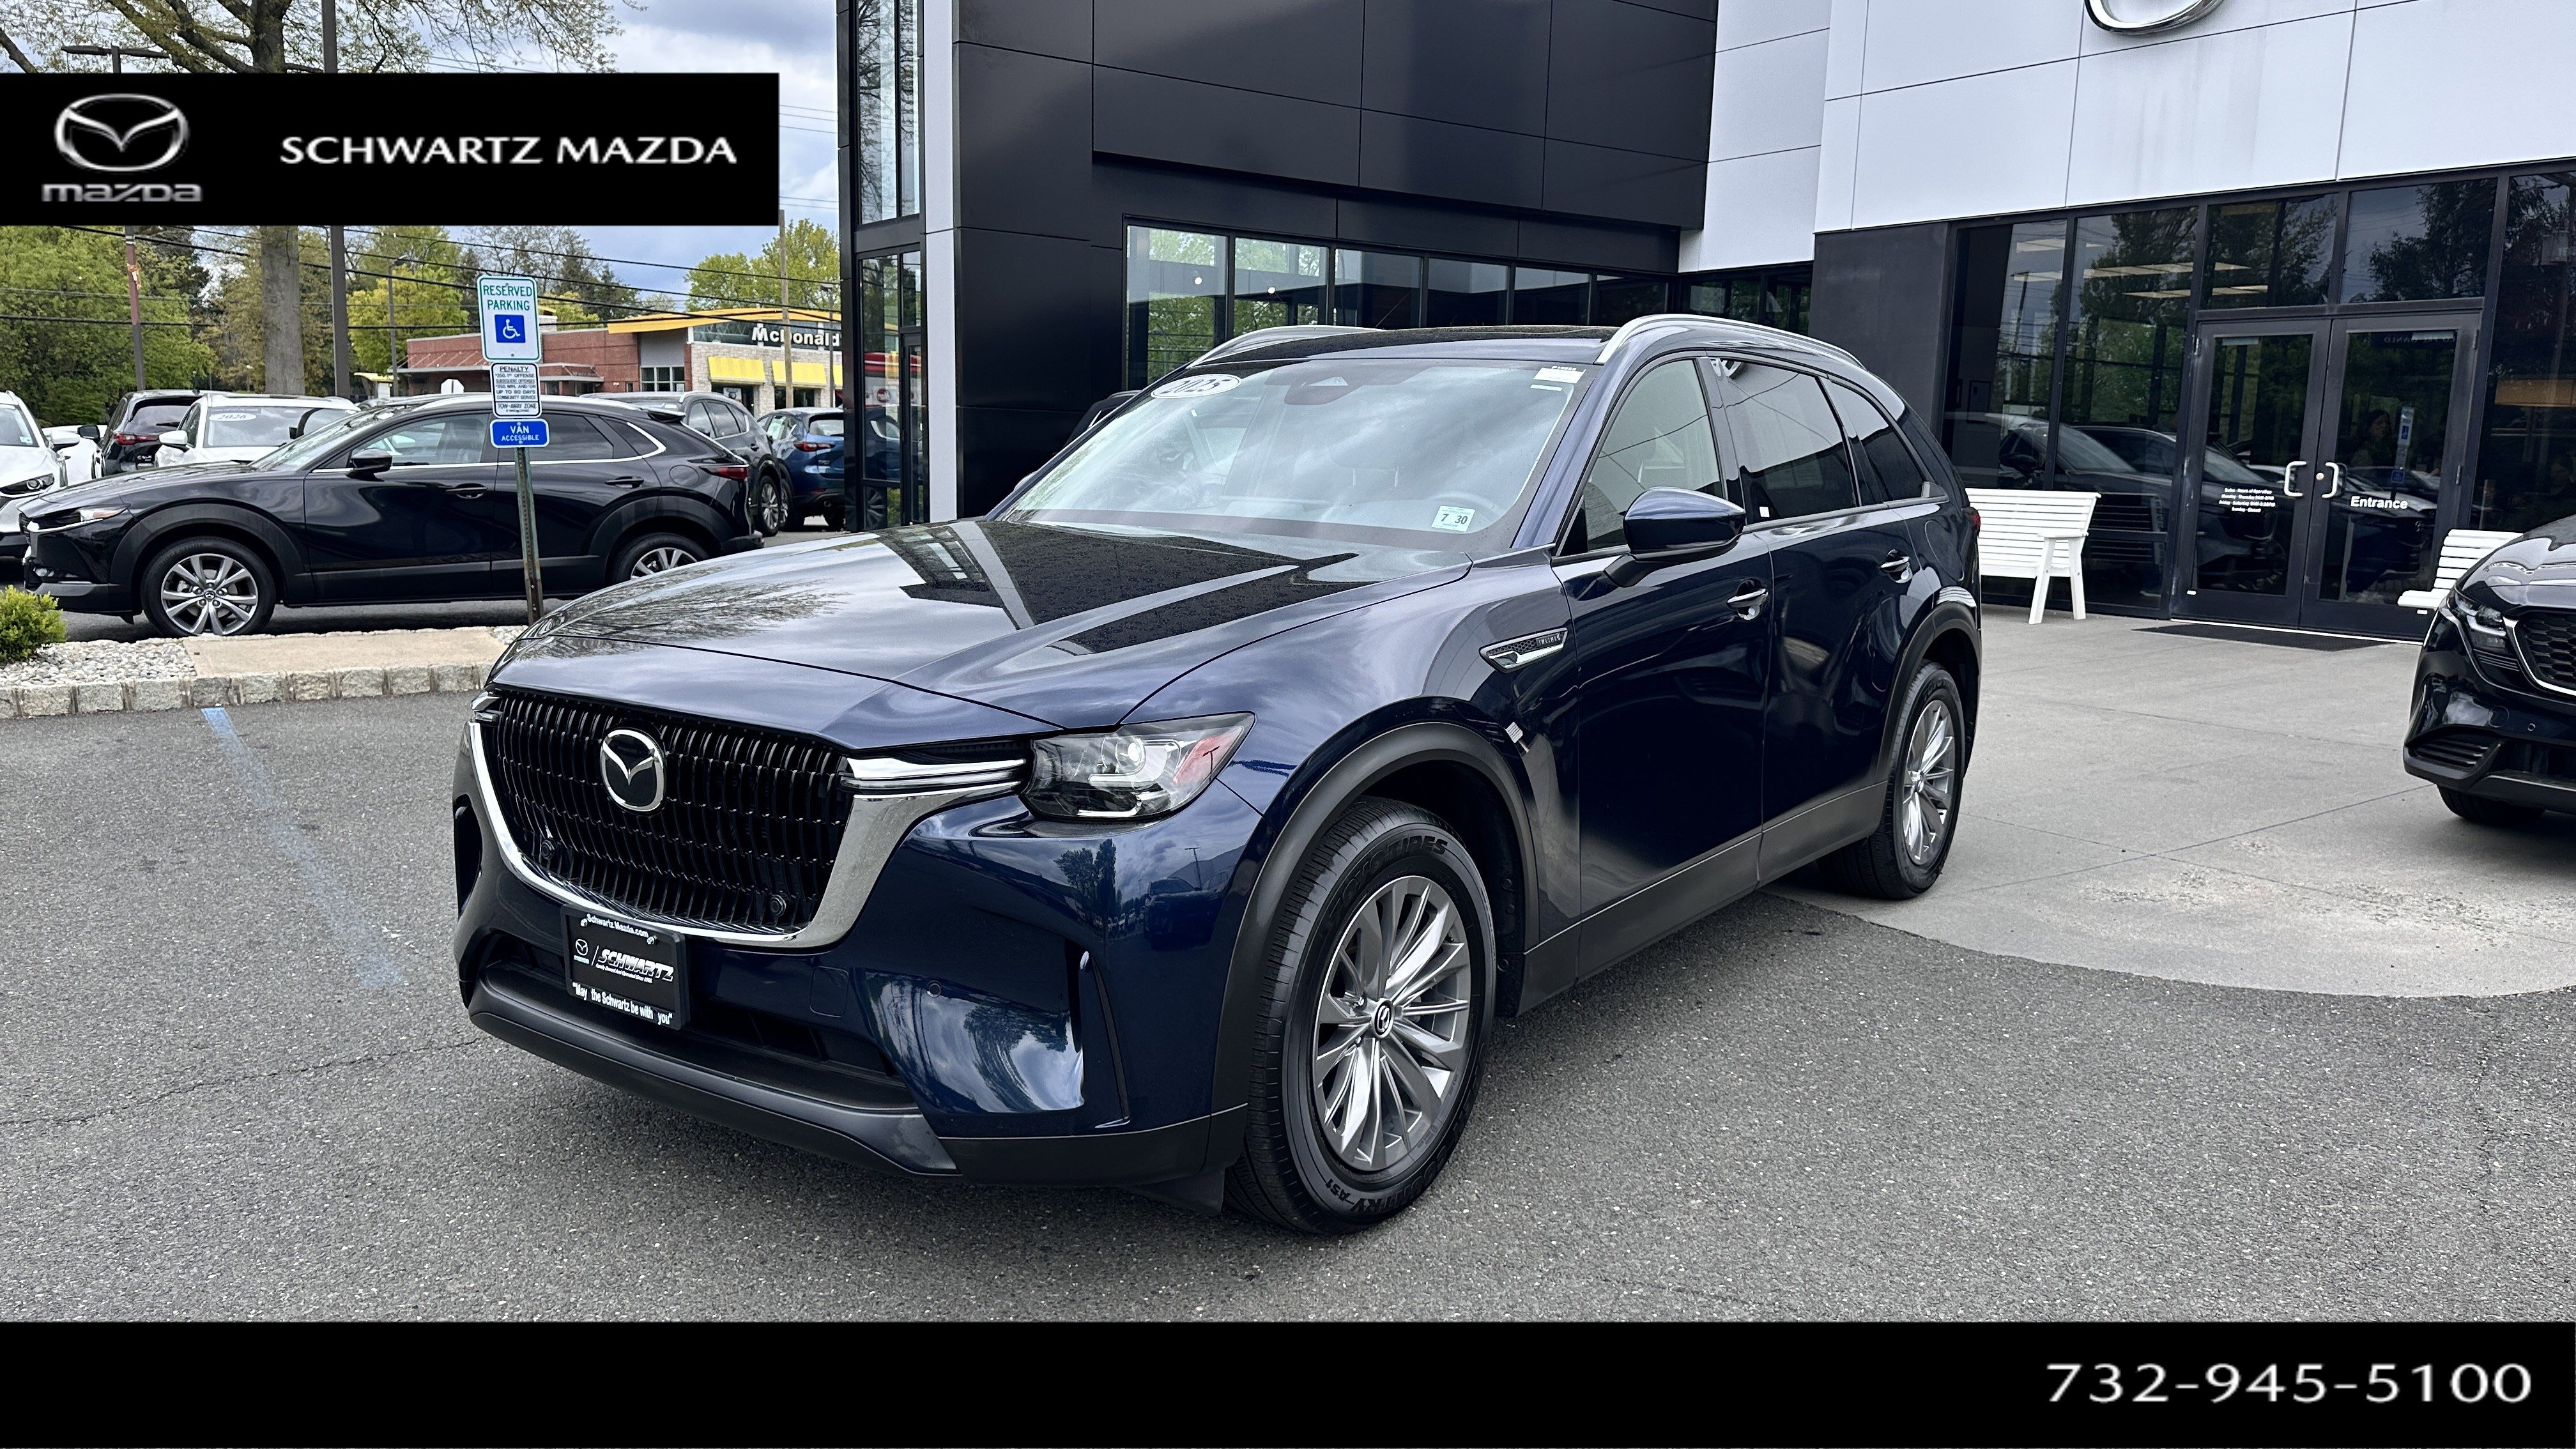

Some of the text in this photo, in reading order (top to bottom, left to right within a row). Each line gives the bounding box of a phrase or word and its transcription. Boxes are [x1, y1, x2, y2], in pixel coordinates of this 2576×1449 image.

[483, 285, 532, 297] RESERVED
[487, 300, 530, 311] PARKING
[509, 425, 530, 434] VAN
[2350, 496, 2409, 509] Entrance
[1440, 513, 1468, 525] 7 30
[597, 949, 674, 982] SCHWARTZ
[590, 988, 601, 1002] the
[601, 991, 631, 1013] Schwartz
[630, 1001, 640, 1015] be
[639, 1005, 654, 1020] with
